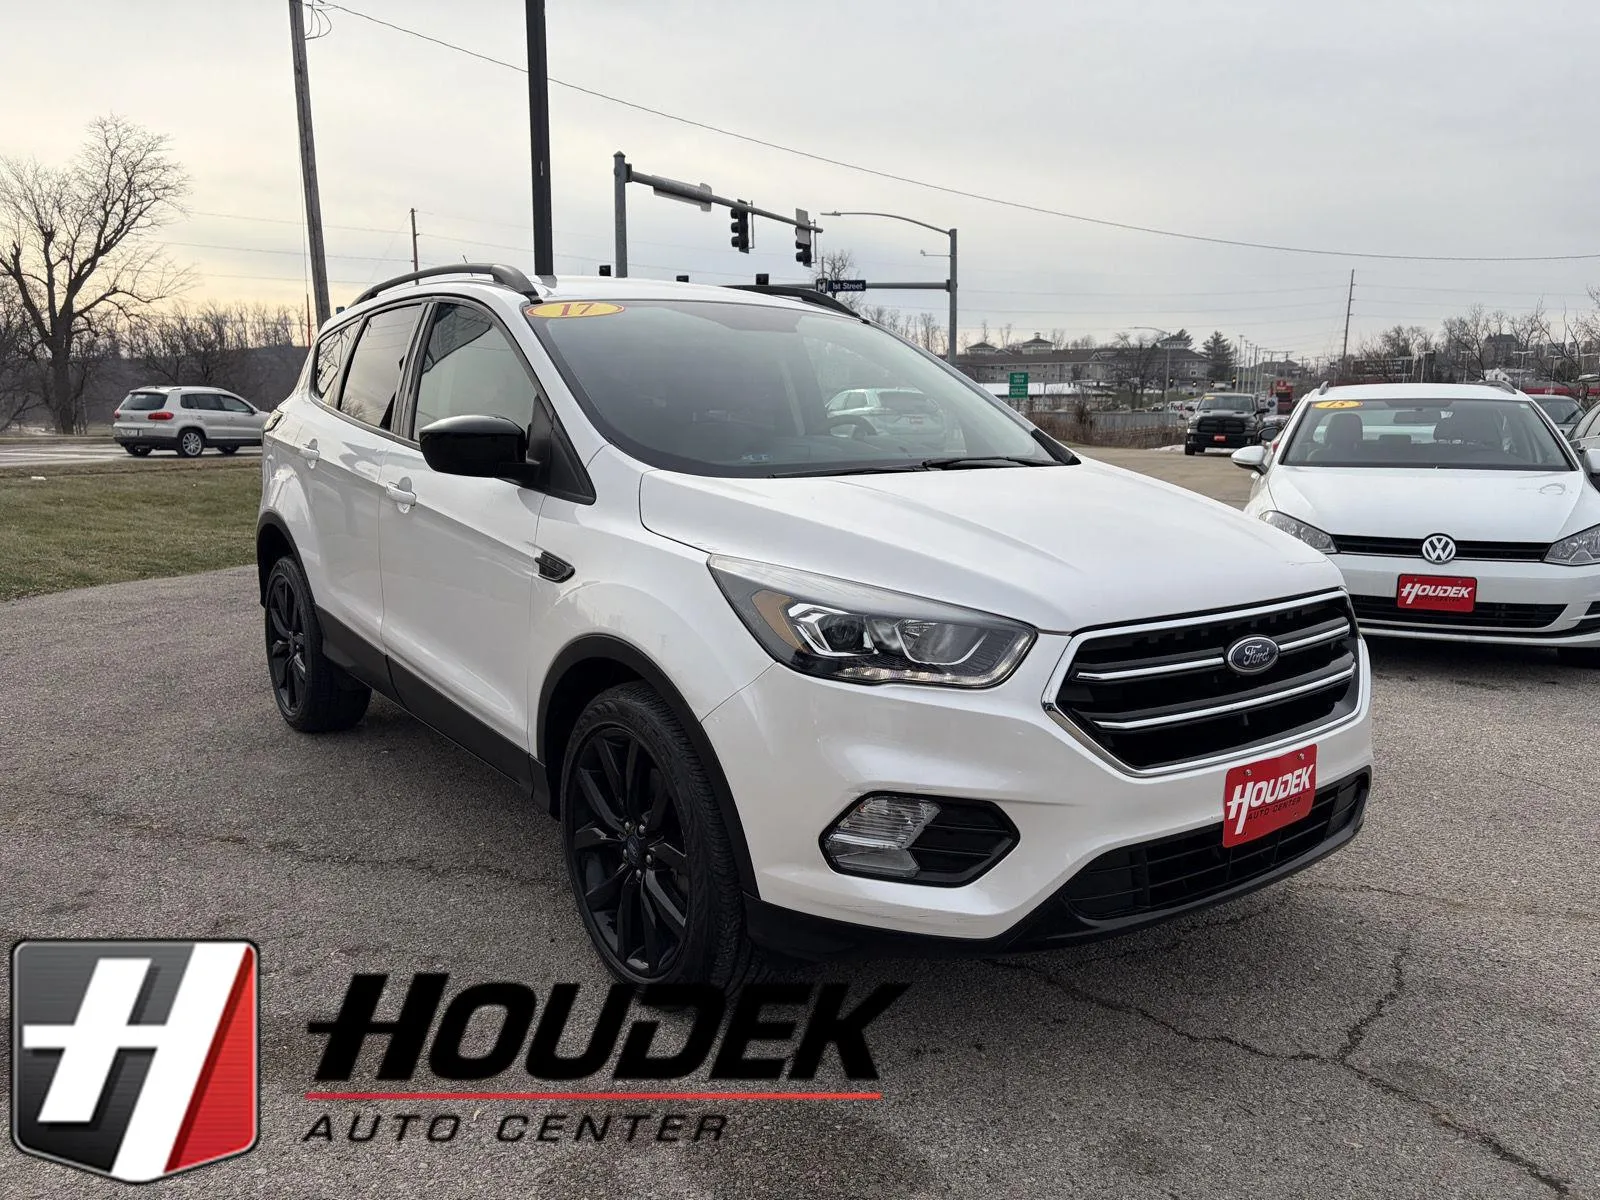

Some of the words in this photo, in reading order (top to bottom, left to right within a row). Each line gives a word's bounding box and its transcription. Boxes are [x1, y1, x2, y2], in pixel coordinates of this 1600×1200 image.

[843, 282, 863, 290] Street
[560, 303, 595, 316] 17
[1401, 583, 1473, 604] HOUDEK
[1243, 644, 1270, 666] Ford
[1227, 764, 1314, 835] HOUDEK
[1248, 808, 1269, 821] AUTO
